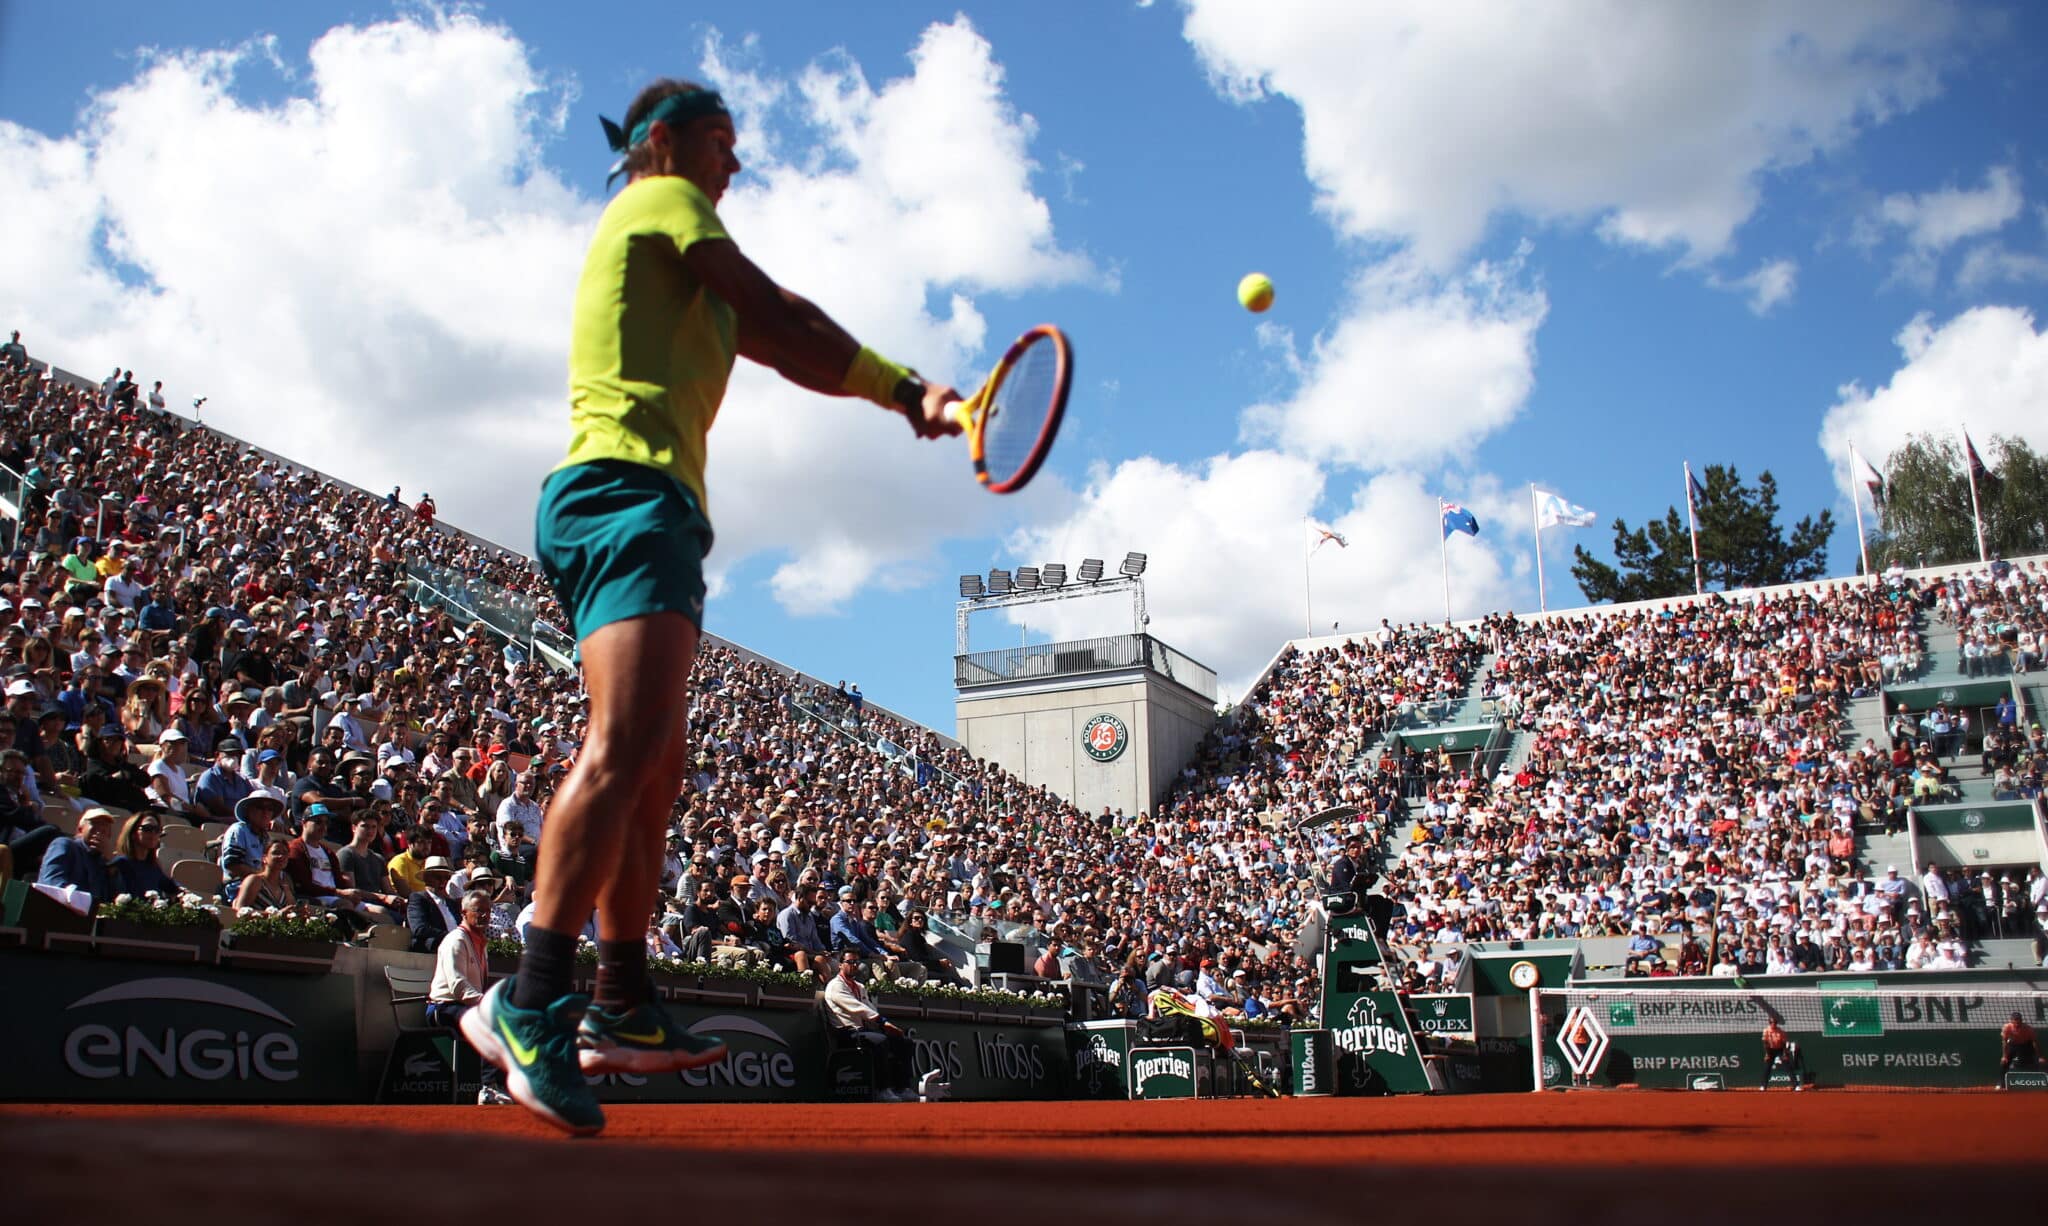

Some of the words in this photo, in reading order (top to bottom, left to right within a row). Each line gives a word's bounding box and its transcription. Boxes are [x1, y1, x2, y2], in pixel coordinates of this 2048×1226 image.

[1083, 716, 1103, 744] ROLAND
[1103, 716, 1123, 740] GARROS
[1090, 747, 1118, 757] PARIS
[1640, 1001, 1675, 1016] BNP
[1681, 1000, 1757, 1015] PARIBAS
[1894, 996, 1985, 1024] BNP
[977, 1031, 1045, 1089] Infosys
[1302, 1036, 1315, 1092] Wilson
[1633, 1057, 1666, 1069] BNP
[1671, 1056, 1740, 1068] PARIBAS
[1843, 1054, 1880, 1067] BNP
[1885, 1053, 1962, 1067] PARIBAS
[393, 1080, 449, 1092] LACOSTE
